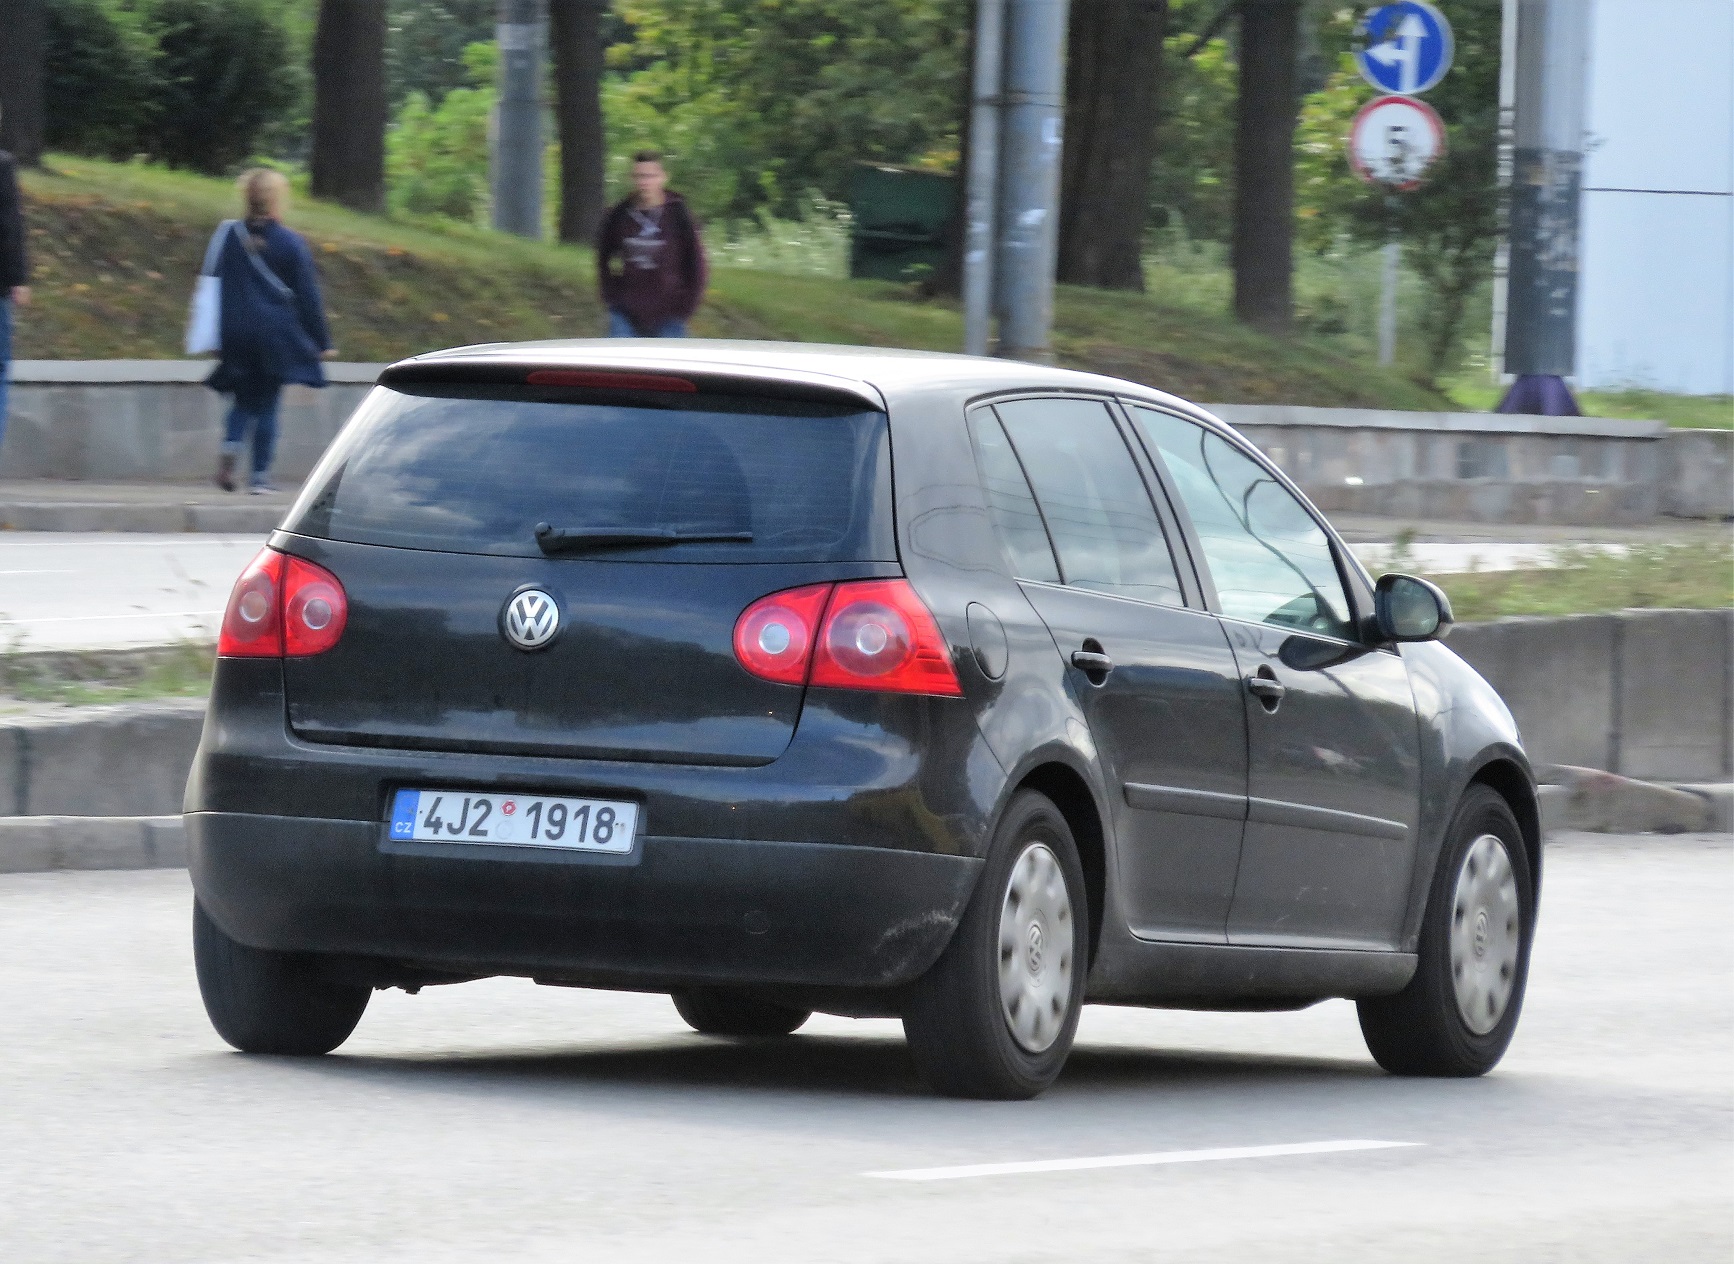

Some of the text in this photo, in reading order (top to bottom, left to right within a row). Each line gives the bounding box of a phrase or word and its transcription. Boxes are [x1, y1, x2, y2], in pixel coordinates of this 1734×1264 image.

[1384, 126, 1411, 165] 5
[507, 591, 558, 645] VW
[394, 821, 412, 833] CZ
[422, 796, 616, 844] 4J2 1918
